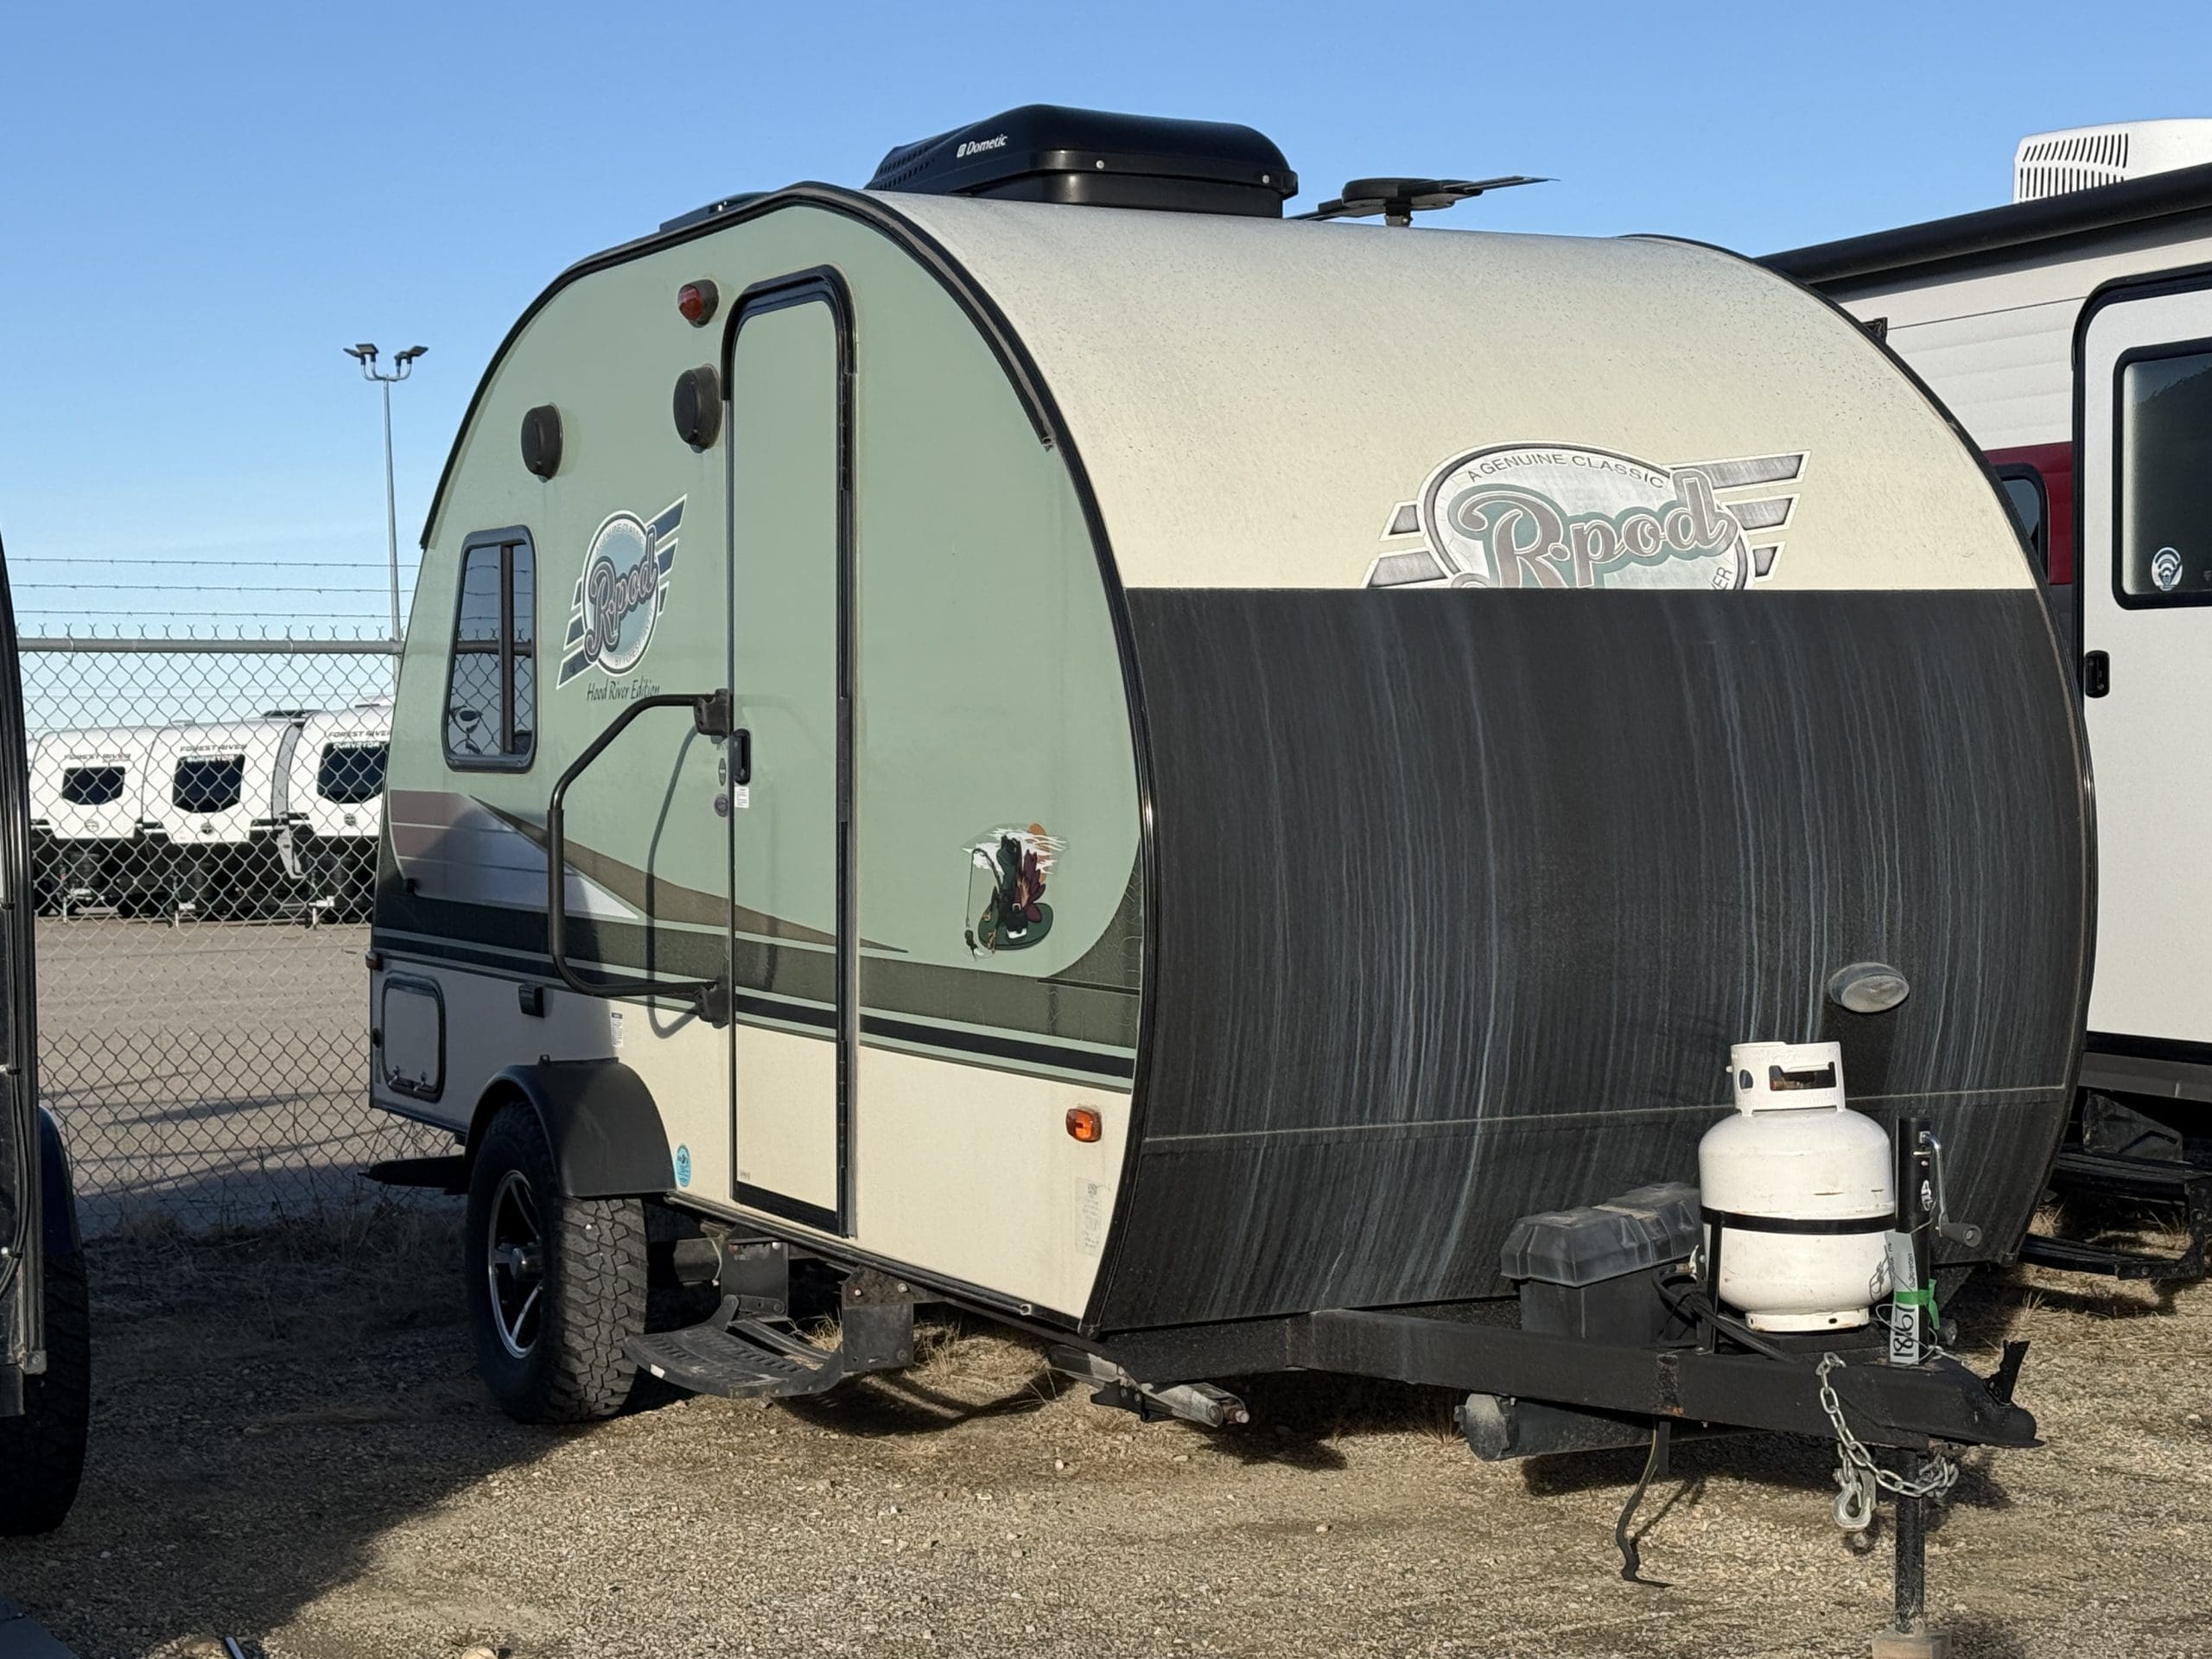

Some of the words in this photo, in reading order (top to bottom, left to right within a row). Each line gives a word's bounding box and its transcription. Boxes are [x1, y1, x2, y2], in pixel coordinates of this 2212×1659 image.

[966, 134, 1007, 156] Dometic
[1466, 470, 1482, 482] A
[1481, 454, 1566, 475] GENUINE
[1572, 455, 1664, 488] CLASSIC
[587, 678, 609, 702] Hood
[608, 680, 629, 701] River
[630, 676, 660, 699] Edition
